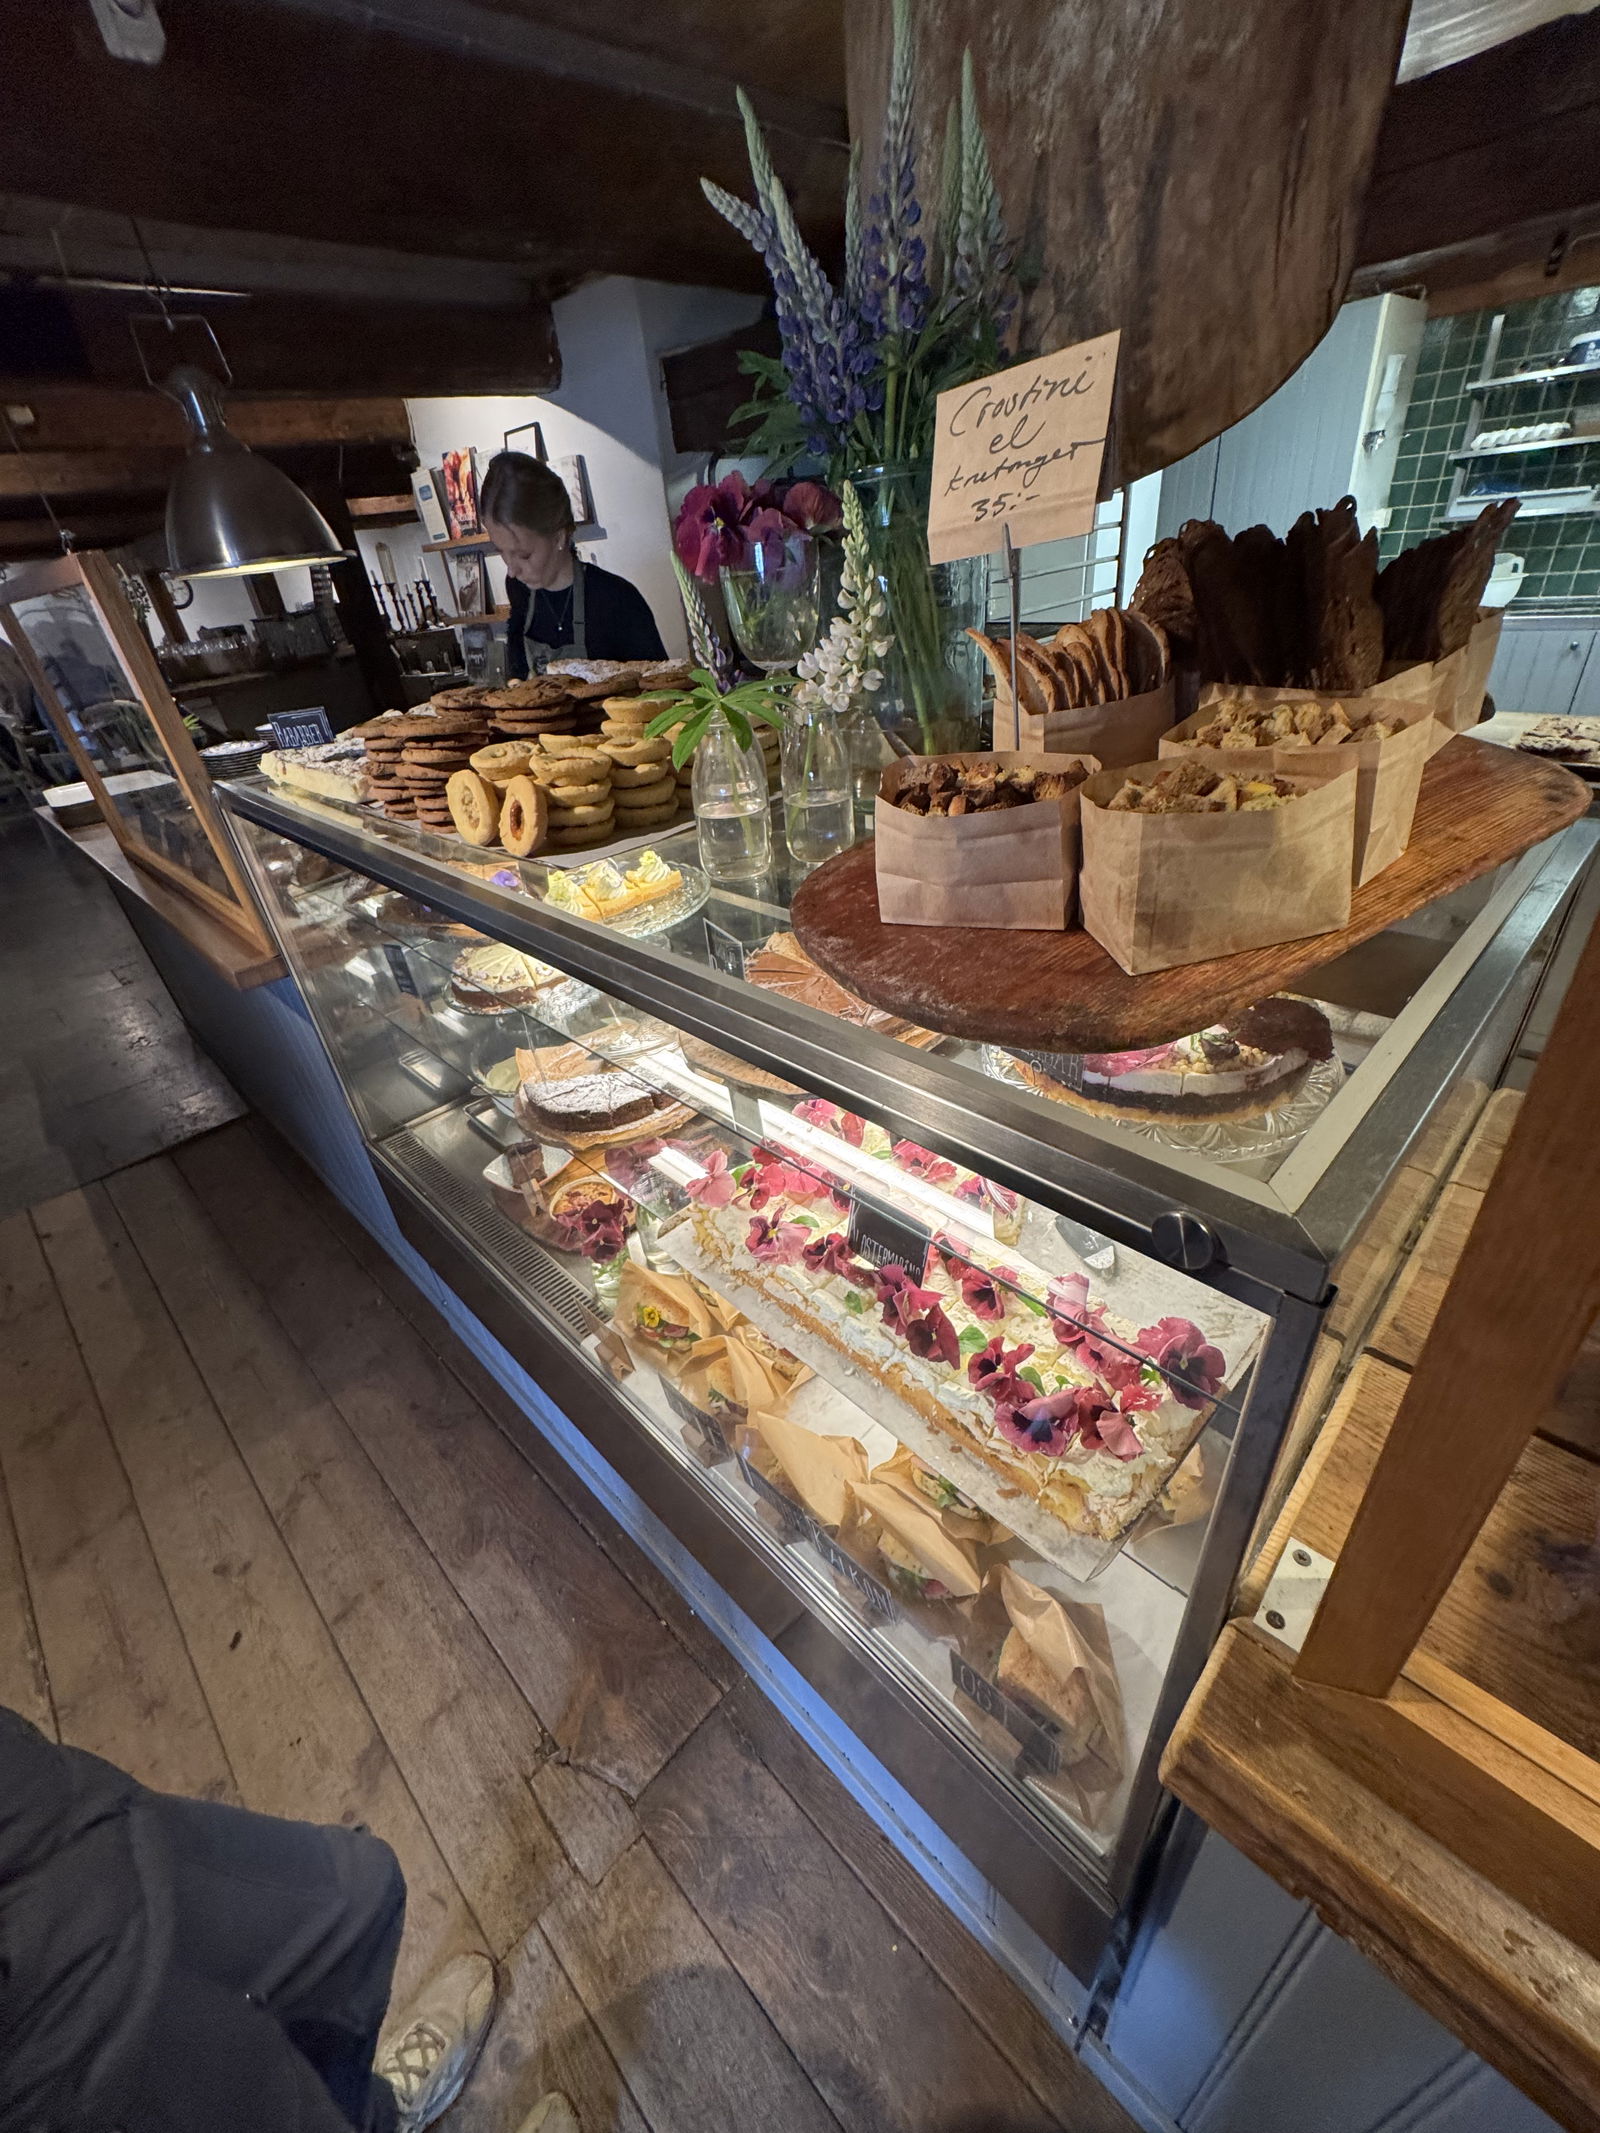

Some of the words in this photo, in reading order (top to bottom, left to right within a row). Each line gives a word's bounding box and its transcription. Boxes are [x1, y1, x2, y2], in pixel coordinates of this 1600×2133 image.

[949, 355, 1096, 437] Crostini
[989, 414, 1046, 455] el
[971, 491, 1040, 523] 35:-
[271, 721, 325, 748] RABARBER
